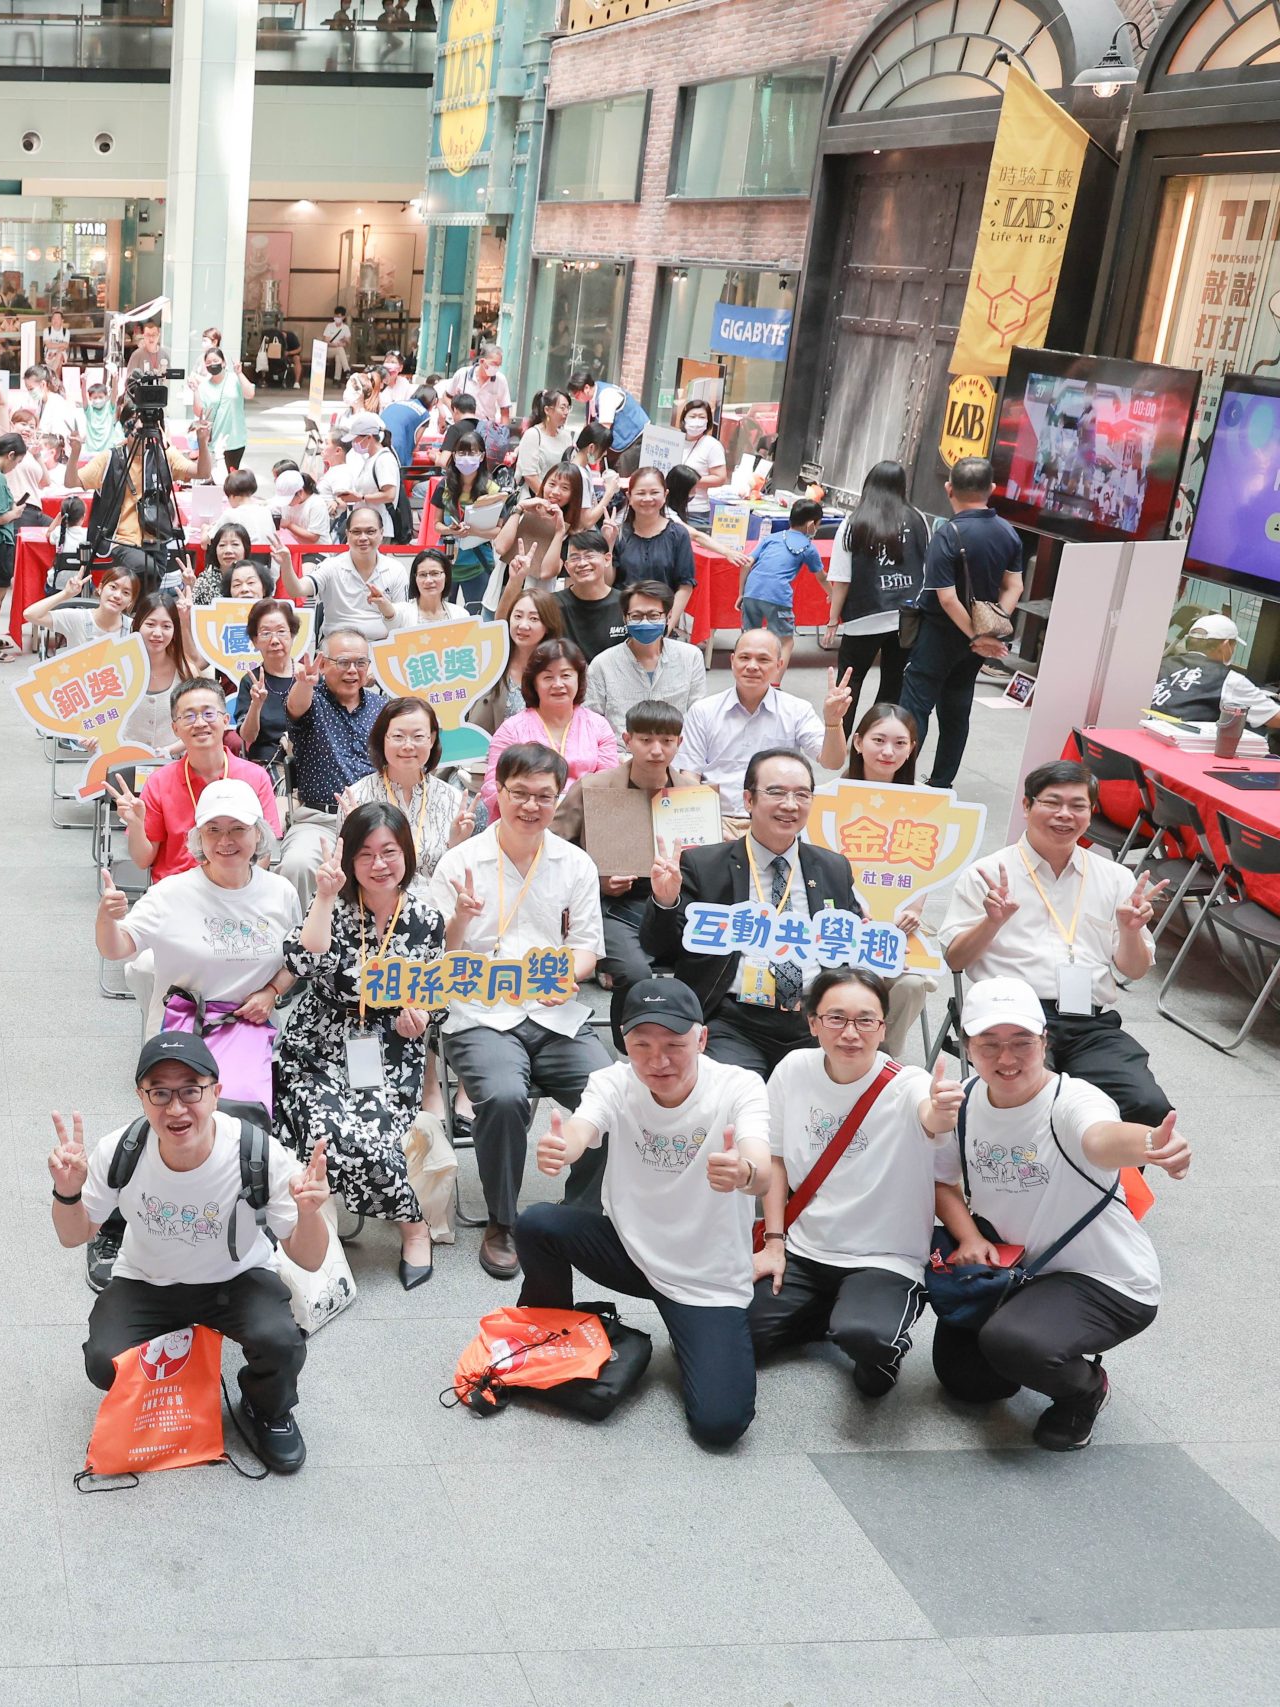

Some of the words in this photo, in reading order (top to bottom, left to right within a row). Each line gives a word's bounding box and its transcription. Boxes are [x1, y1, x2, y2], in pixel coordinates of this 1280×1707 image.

[999, 165, 1074, 188] 時驗工廠
[1003, 197, 1055, 229] LAB
[1218, 200, 1280, 241] TI
[991, 231, 1012, 242] Life
[1016, 233, 1033, 244] Art
[1038, 234, 1057, 245] Bar
[1210, 253, 1261, 265] WORKSHOP
[1201, 270, 1257, 307] 敲敲
[720, 318, 791, 346] GIGABYTE
[1194, 313, 1247, 351] 打打
[1035, 384, 1047, 398] 37
[946, 400, 985, 442] LAB
[1132, 400, 1157, 418] 00:00
[222, 623, 257, 655] 優
[237, 660, 261, 672] 社會
[405, 648, 478, 690] 銀獎
[52, 665, 125, 719] 銅獎
[428, 687, 468, 705] 社會組
[82, 707, 120, 731] 社會組
[840, 815, 940, 872] 金獎
[862, 871, 912, 888] 社會組
[691, 909, 900, 964] 互動共學趣
[366, 953, 570, 1005] 祖孫聚同樂
